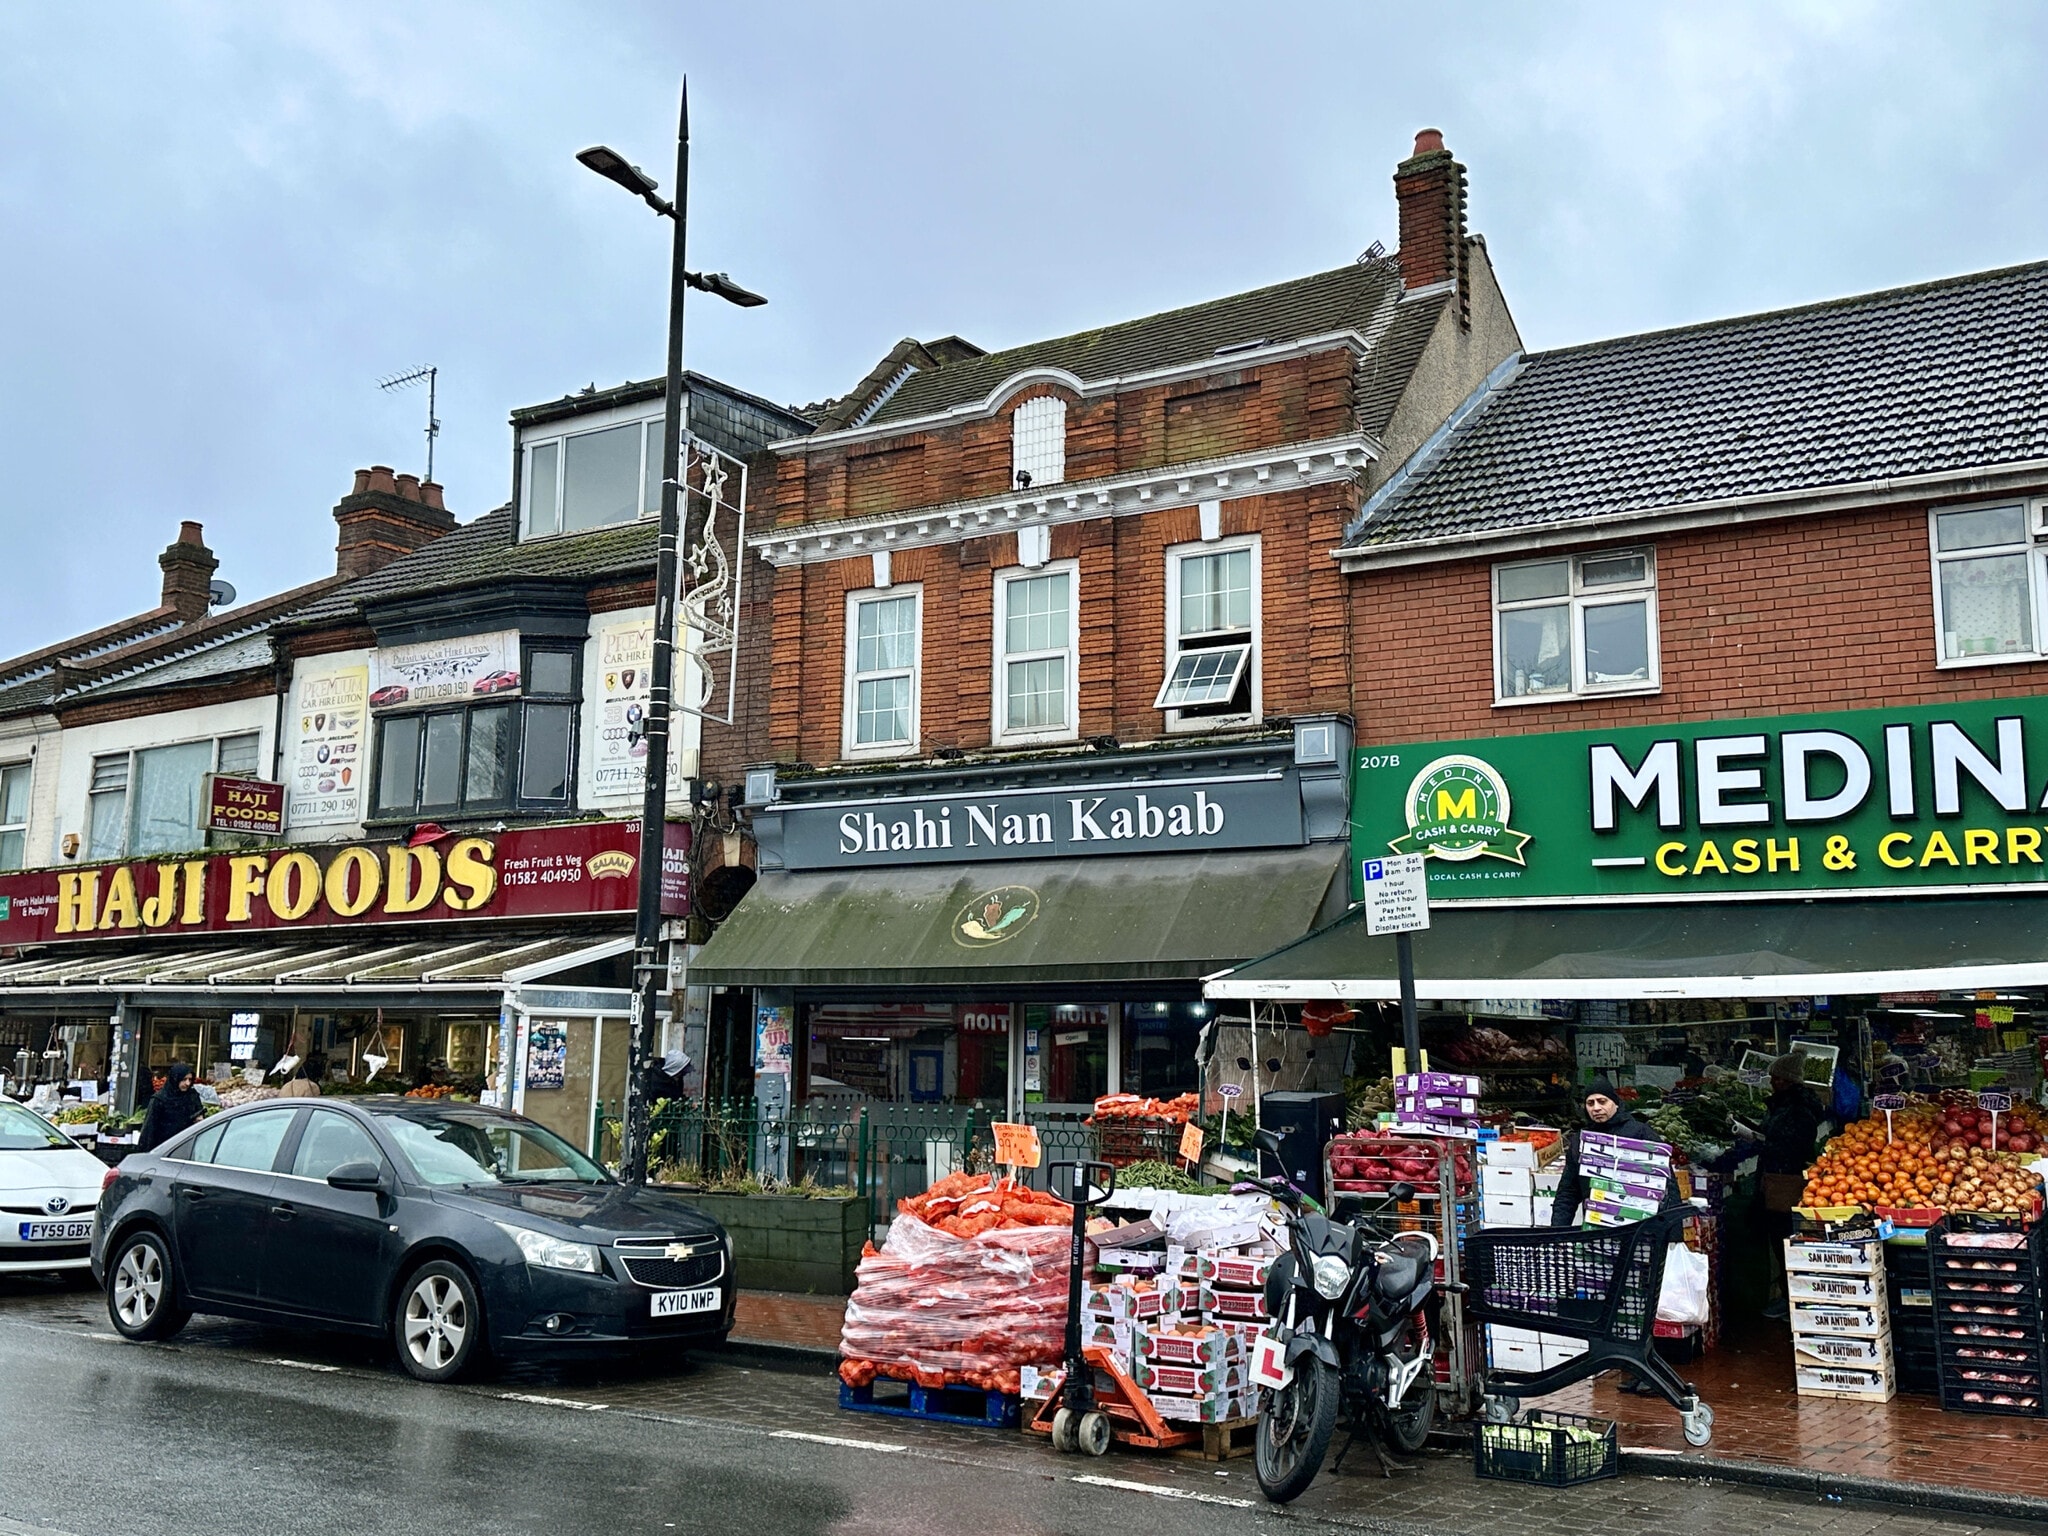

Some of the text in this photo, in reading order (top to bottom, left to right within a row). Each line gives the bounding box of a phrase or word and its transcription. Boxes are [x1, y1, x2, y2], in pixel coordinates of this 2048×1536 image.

[427, 649, 443, 660] CAR
[444, 647, 463, 658] HIRE
[464, 644, 489, 656] LUTON
[603, 654, 623, 664] CAR
[303, 678, 362, 699] PREMIUM
[414, 681, 468, 700] 07711 290 190
[301, 693, 362, 709] CAR HIRE LUTON
[1360, 755, 1400, 769] 207B
[596, 768, 628, 782] 07711
[1588, 715, 2048, 832] MEDIN
[1418, 768, 1495, 803] MEDINA
[227, 790, 268, 809] HAJI
[291, 798, 357, 815] 07711 290 190
[1437, 788, 1476, 821] M
[213, 805, 280, 822] FOODS
[216, 818, 228, 827] TEL
[625, 823, 641, 834] 203
[839, 791, 1225, 855] Shahi Nan Kabab
[1415, 824, 1501, 841] CASH & CARRY
[1655, 826, 2048, 876] CASH & CARR
[504, 855, 582, 870] Fresh Fruit & Veg
[1406, 857, 1419, 865] Sat
[503, 868, 582, 886] 01582 404950
[1368, 863, 1380, 879] P
[1492, 871, 1521, 879] CARRY
[55, 838, 498, 934] HAJI FOODS
[1389, 880, 1405, 888] hour
[13, 897, 29, 907] Fresh
[30, 895, 44, 905] Halal
[28, 906, 49, 917] Poultry
[1382, 907, 1394, 915] Pay
[1388, 912, 1416, 921] machine
[1375, 920, 1422, 932] Display ticket
[30, 1221, 92, 1238] FY59 GBX
[1837, 1228, 1873, 1241] PARDO
[1808, 1252, 1853, 1264] SAN ANTONIO
[1812, 1282, 1857, 1295] SAN ANTONIO
[659, 1291, 714, 1313] KY10 NWP
[1815, 1315, 1860, 1327] SAN ANTONIO
[1817, 1344, 1832, 1355] SAN
[1833, 1346, 1862, 1358] ANTONIO
[1262, 1348, 1284, 1381] L
[1820, 1373, 1865, 1386] SAN ANTONIO
